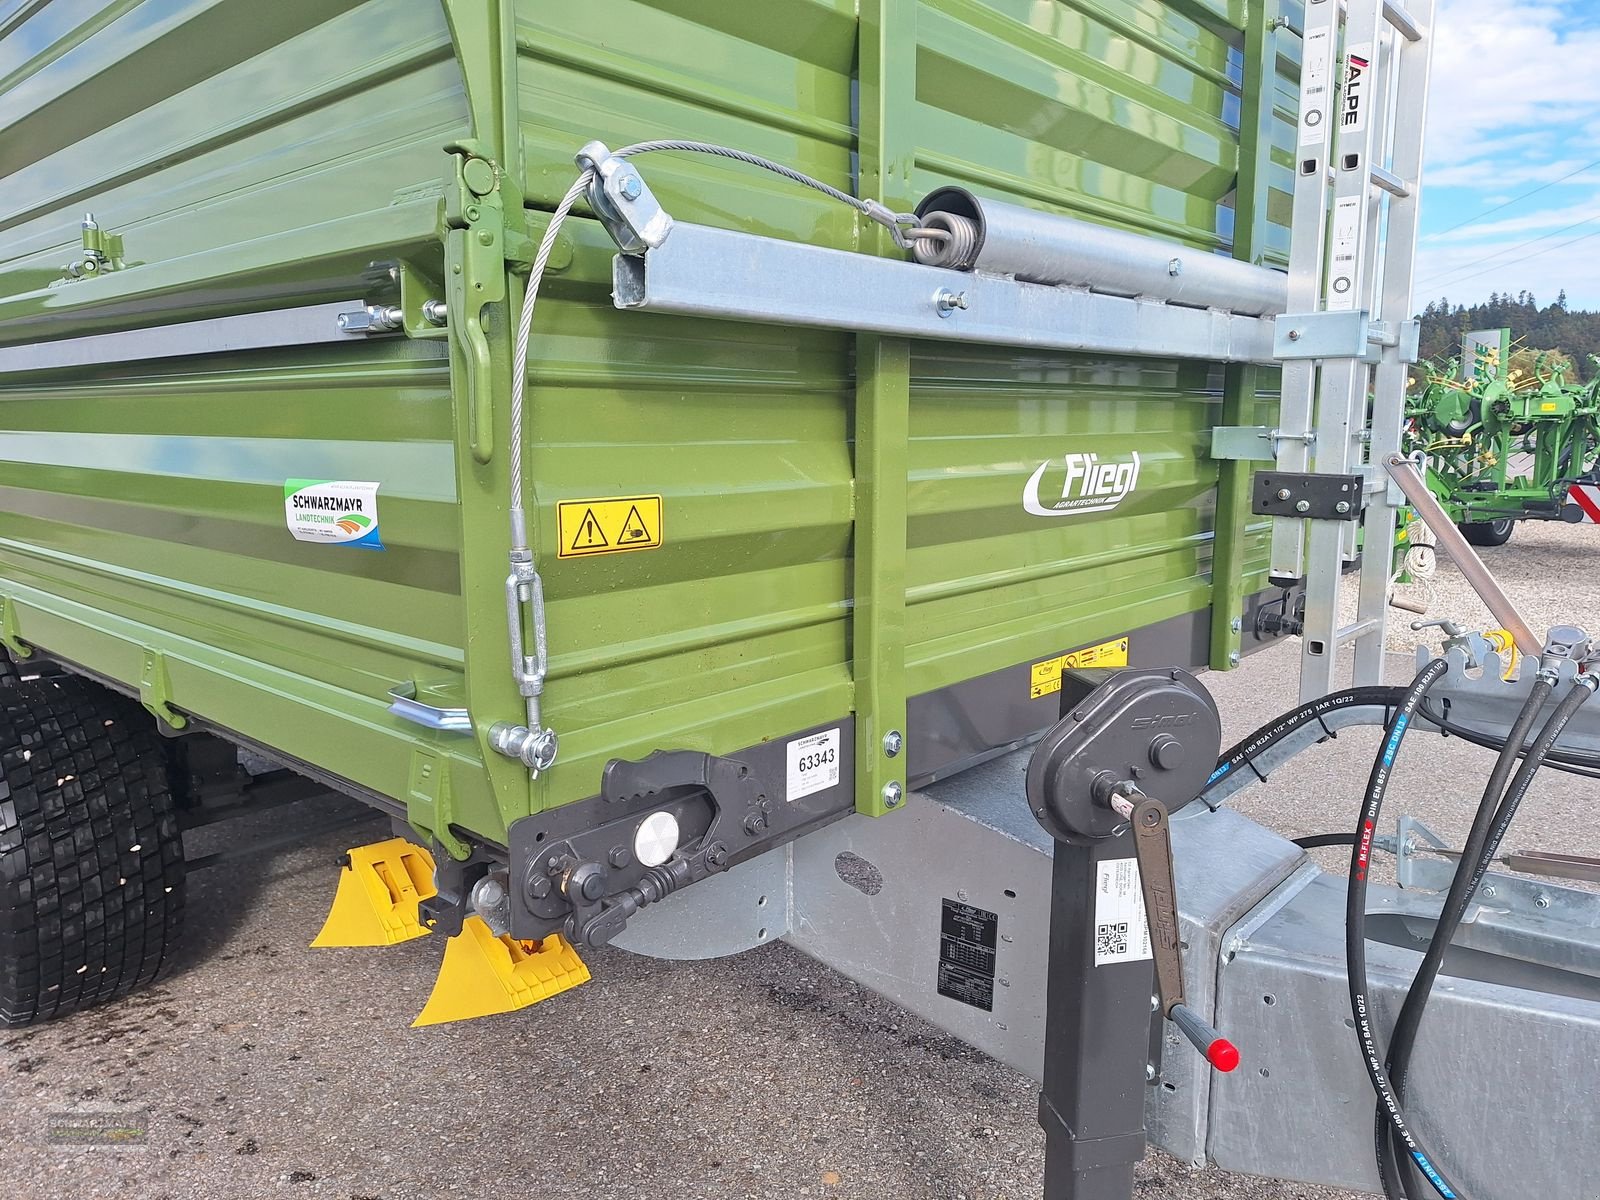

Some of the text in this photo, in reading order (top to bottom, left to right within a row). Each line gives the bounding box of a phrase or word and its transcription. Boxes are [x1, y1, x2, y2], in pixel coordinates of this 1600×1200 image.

[1345, 66, 1361, 125] ALPE
[1061, 451, 1140, 502] Fliegl
[293, 495, 362, 511] SCHWARZMAYR
[1053, 497, 1106, 509] AGRARTECHNIK
[296, 514, 335, 524] LANDTECHNIK
[1245, 744, 1257, 755] 100
[1256, 731, 1274, 747] R2AT
[1286, 715, 1299, 726] WP
[1299, 708, 1313, 719] 275
[1331, 696, 1354, 706] 1Q/22
[1368, 801, 1378, 817] DIN
[1373, 786, 1382, 799] EN
[1378, 769, 1387, 784] 857
[1405, 696, 1416, 713] SAE
[1414, 684, 1425, 696] 100
[799, 748, 835, 772] 63343
[1357, 994, 1366, 1018] 1Q/22
[1361, 1020, 1371, 1038] BAR
[1366, 1040, 1376, 1055] 275
[1370, 1057, 1380, 1071] WP
[1382, 1090, 1397, 1113] R2AT
[1393, 1114, 1404, 1128] 100
[1401, 1130, 1416, 1148] SAE
